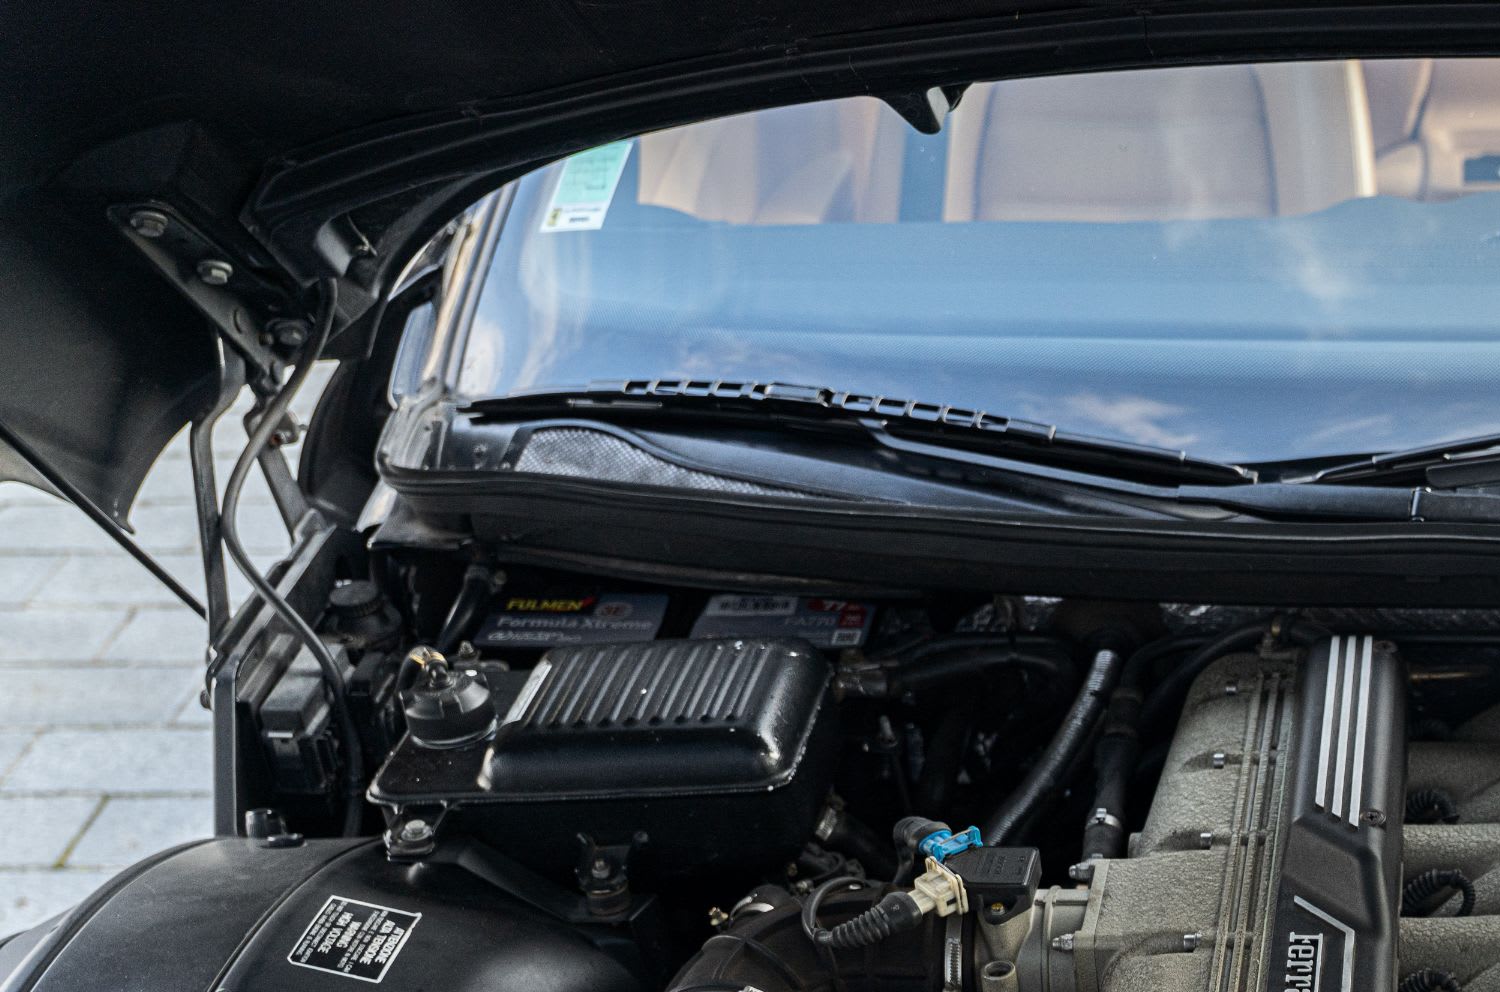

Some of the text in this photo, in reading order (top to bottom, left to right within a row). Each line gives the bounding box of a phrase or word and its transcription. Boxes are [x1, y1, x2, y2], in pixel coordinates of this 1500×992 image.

[507, 598, 582, 611] FULMEN
[498, 615, 653, 629] Formula Xtreme
